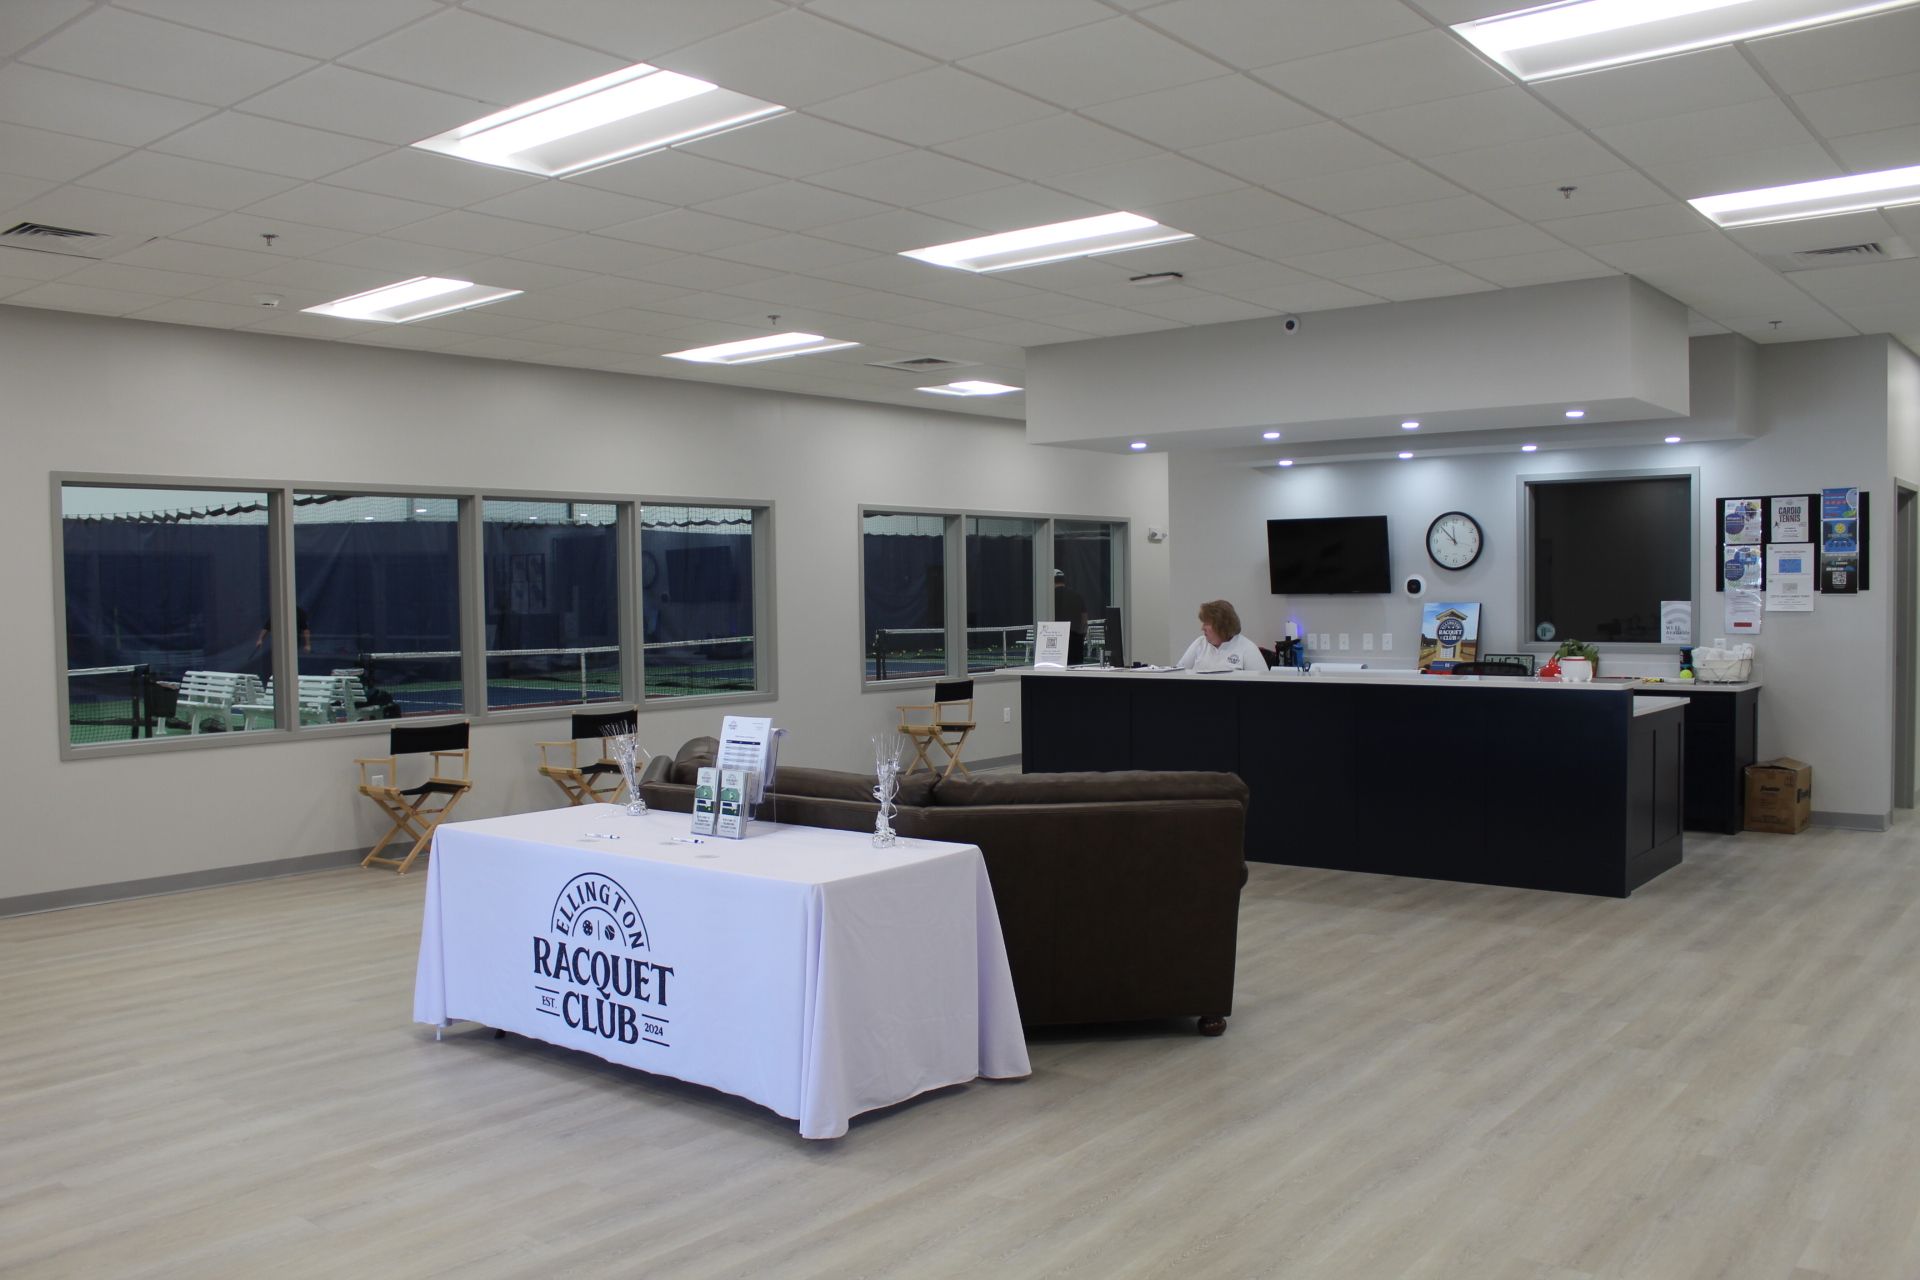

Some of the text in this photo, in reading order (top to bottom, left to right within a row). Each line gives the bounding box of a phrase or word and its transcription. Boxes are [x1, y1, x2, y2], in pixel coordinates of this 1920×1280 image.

[1778, 506, 1802, 515] CARDIO
[1779, 514, 1801, 523] TENNIS
[556, 881, 645, 950] ELLINGTON
[533, 936, 675, 1007] RACQUET
[541, 990, 664, 1045] EST. CLUB 2024
